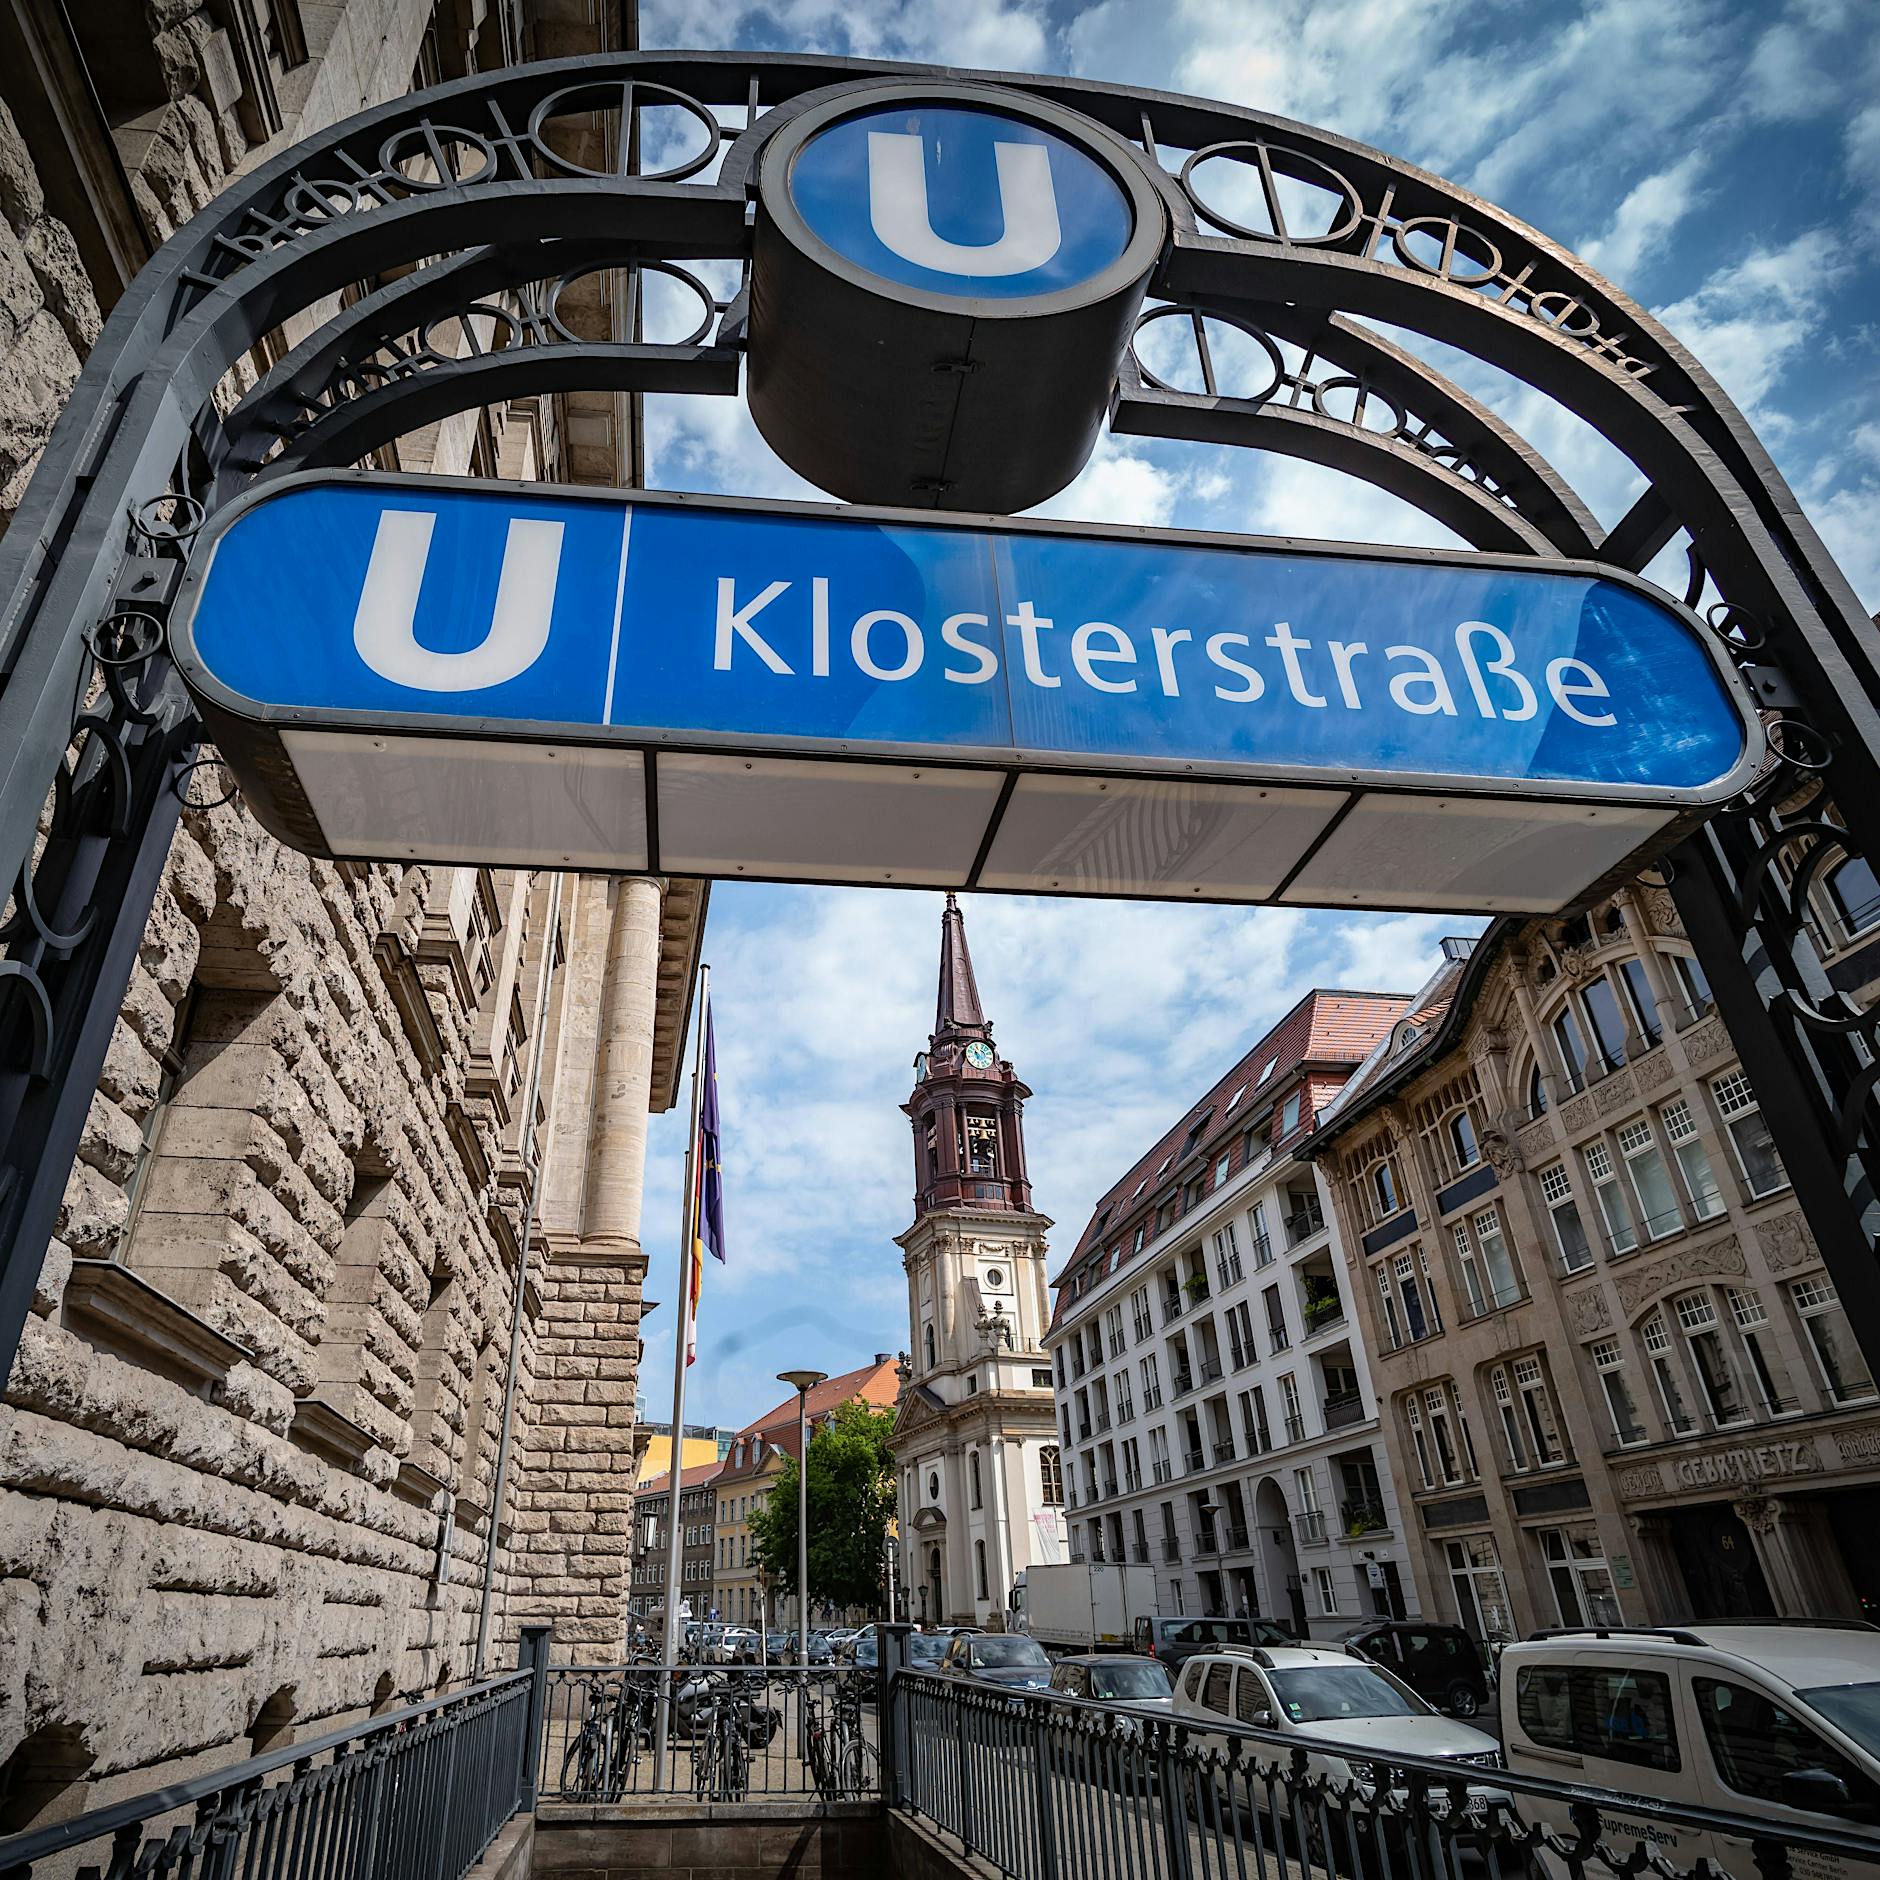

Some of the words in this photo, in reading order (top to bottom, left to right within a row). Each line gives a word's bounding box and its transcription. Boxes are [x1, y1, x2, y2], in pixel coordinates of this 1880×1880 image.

[868, 131, 1061, 277] U
[353, 510, 565, 692] U
[712, 576, 1617, 728] Klosterstraße
